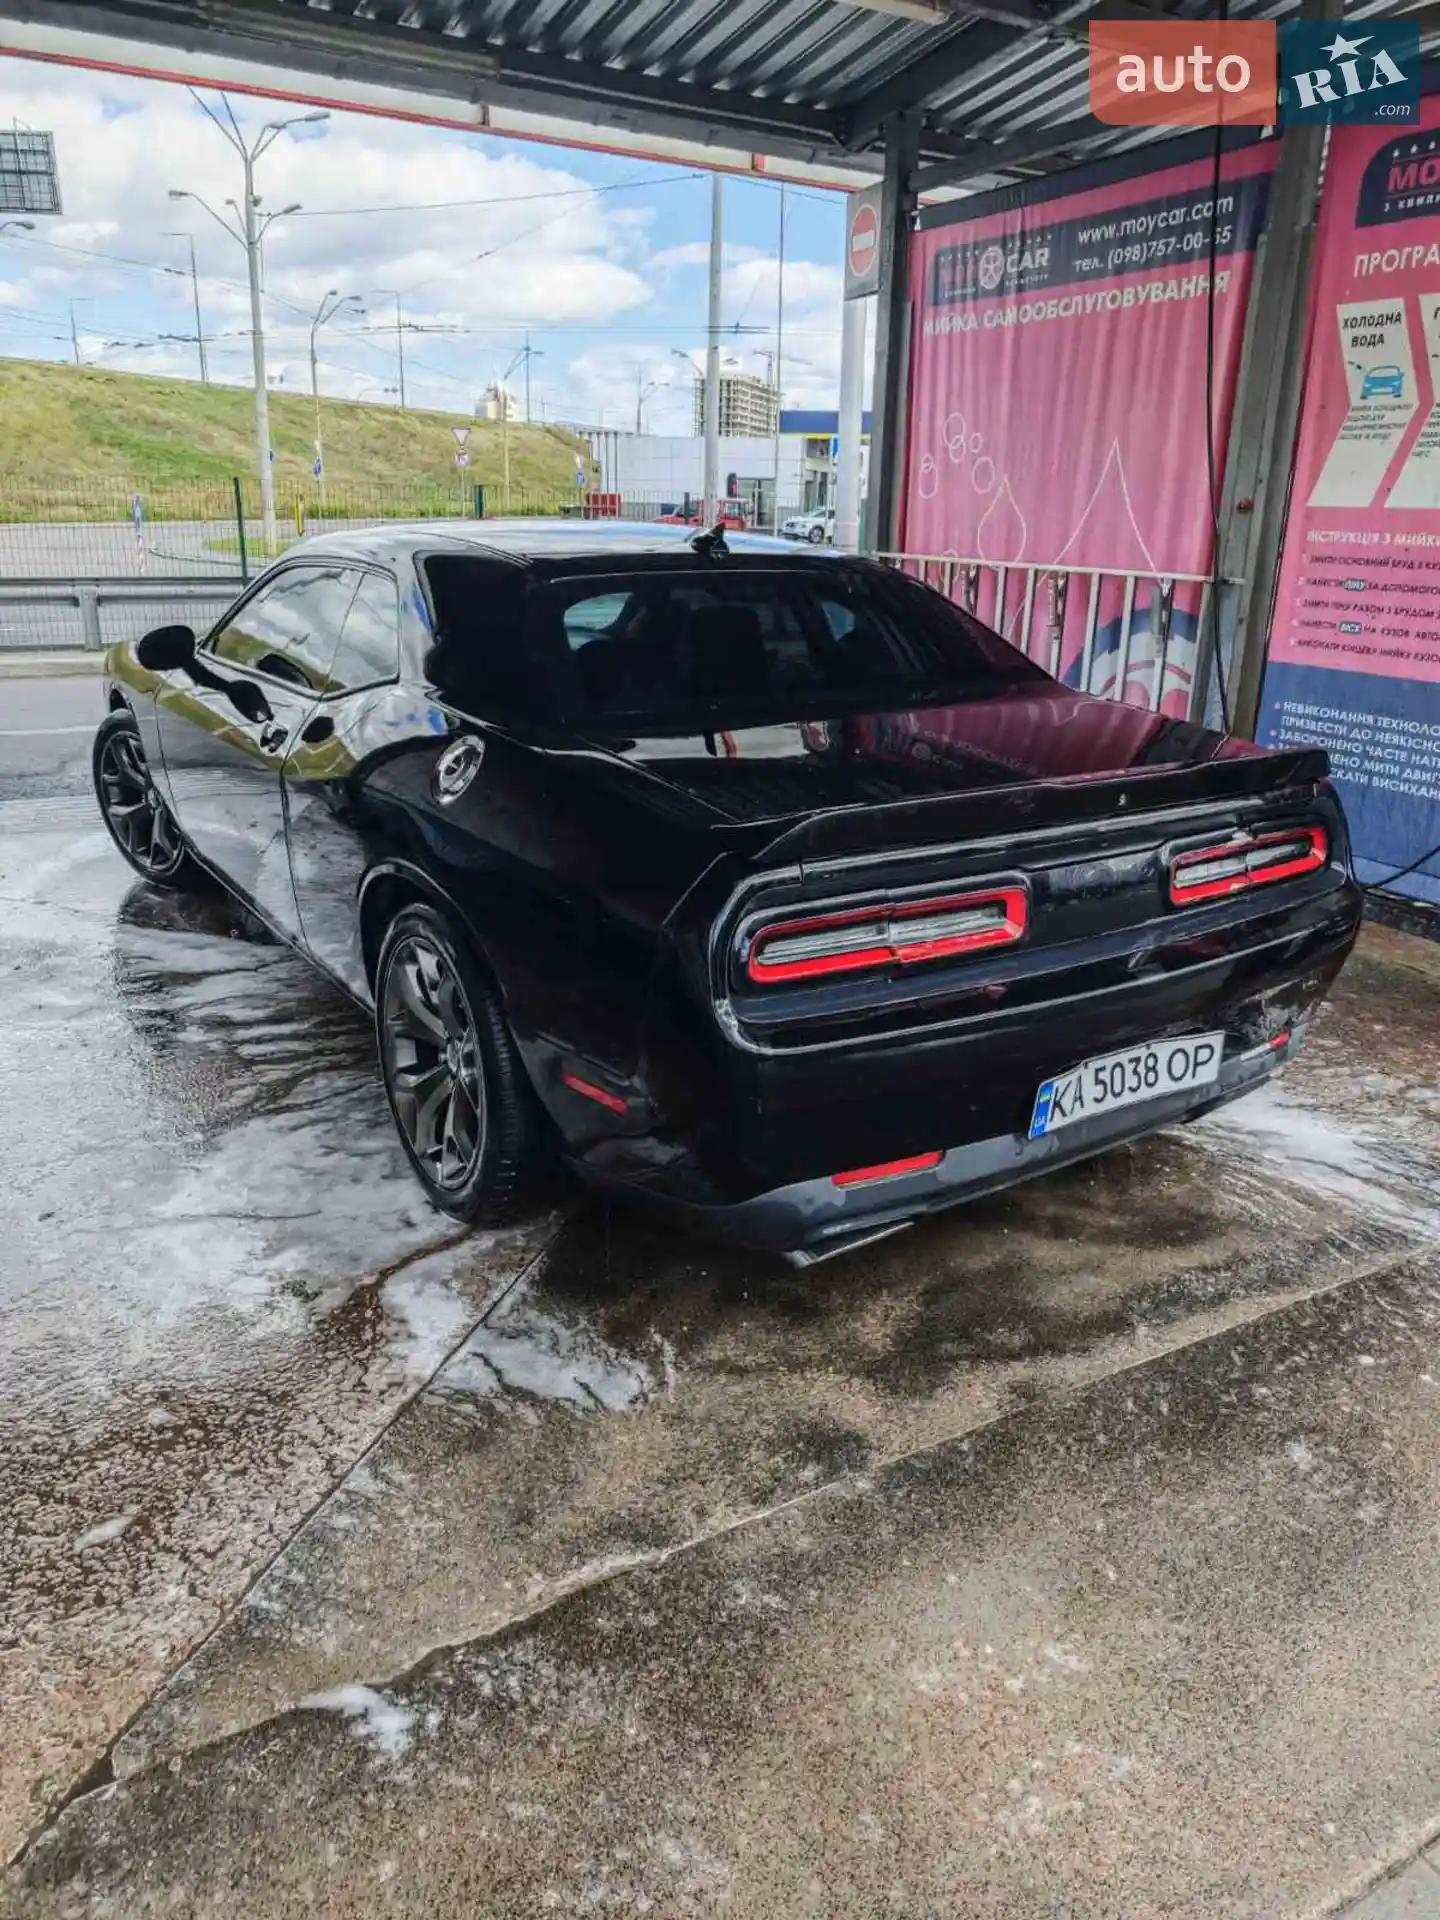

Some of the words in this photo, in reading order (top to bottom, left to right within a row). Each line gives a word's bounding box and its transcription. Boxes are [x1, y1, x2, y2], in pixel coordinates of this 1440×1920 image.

[1078, 196, 1234, 246] www.moycar.com
[1006, 247, 1050, 273] CAR
[1073, 257, 1104, 273] тел.
[1353, 243, 1440, 278] ПРОГРА
[983, 270, 1230, 328] САМООБСЛУГОВУВАННЯ
[1343, 311, 1402, 330] ХОЛОДНА
[1351, 333, 1385, 349] ВОДА
[1283, 701, 1374, 725] НЕВИКОНАННЯ
[1281, 715, 1348, 737] ПРИЗВЕСТИ
[1350, 727, 1373, 740] ДО
[1279, 728, 1363, 754] ЗАБОРОНЕНО
[1366, 743, 1409, 763] ЧАСТЕ
[1362, 759, 1400, 776] МИТИ
[1050, 1075, 1084, 1122] KA
[1093, 1052, 1159, 1103] 5038
[1166, 1043, 1214, 1082] OP
